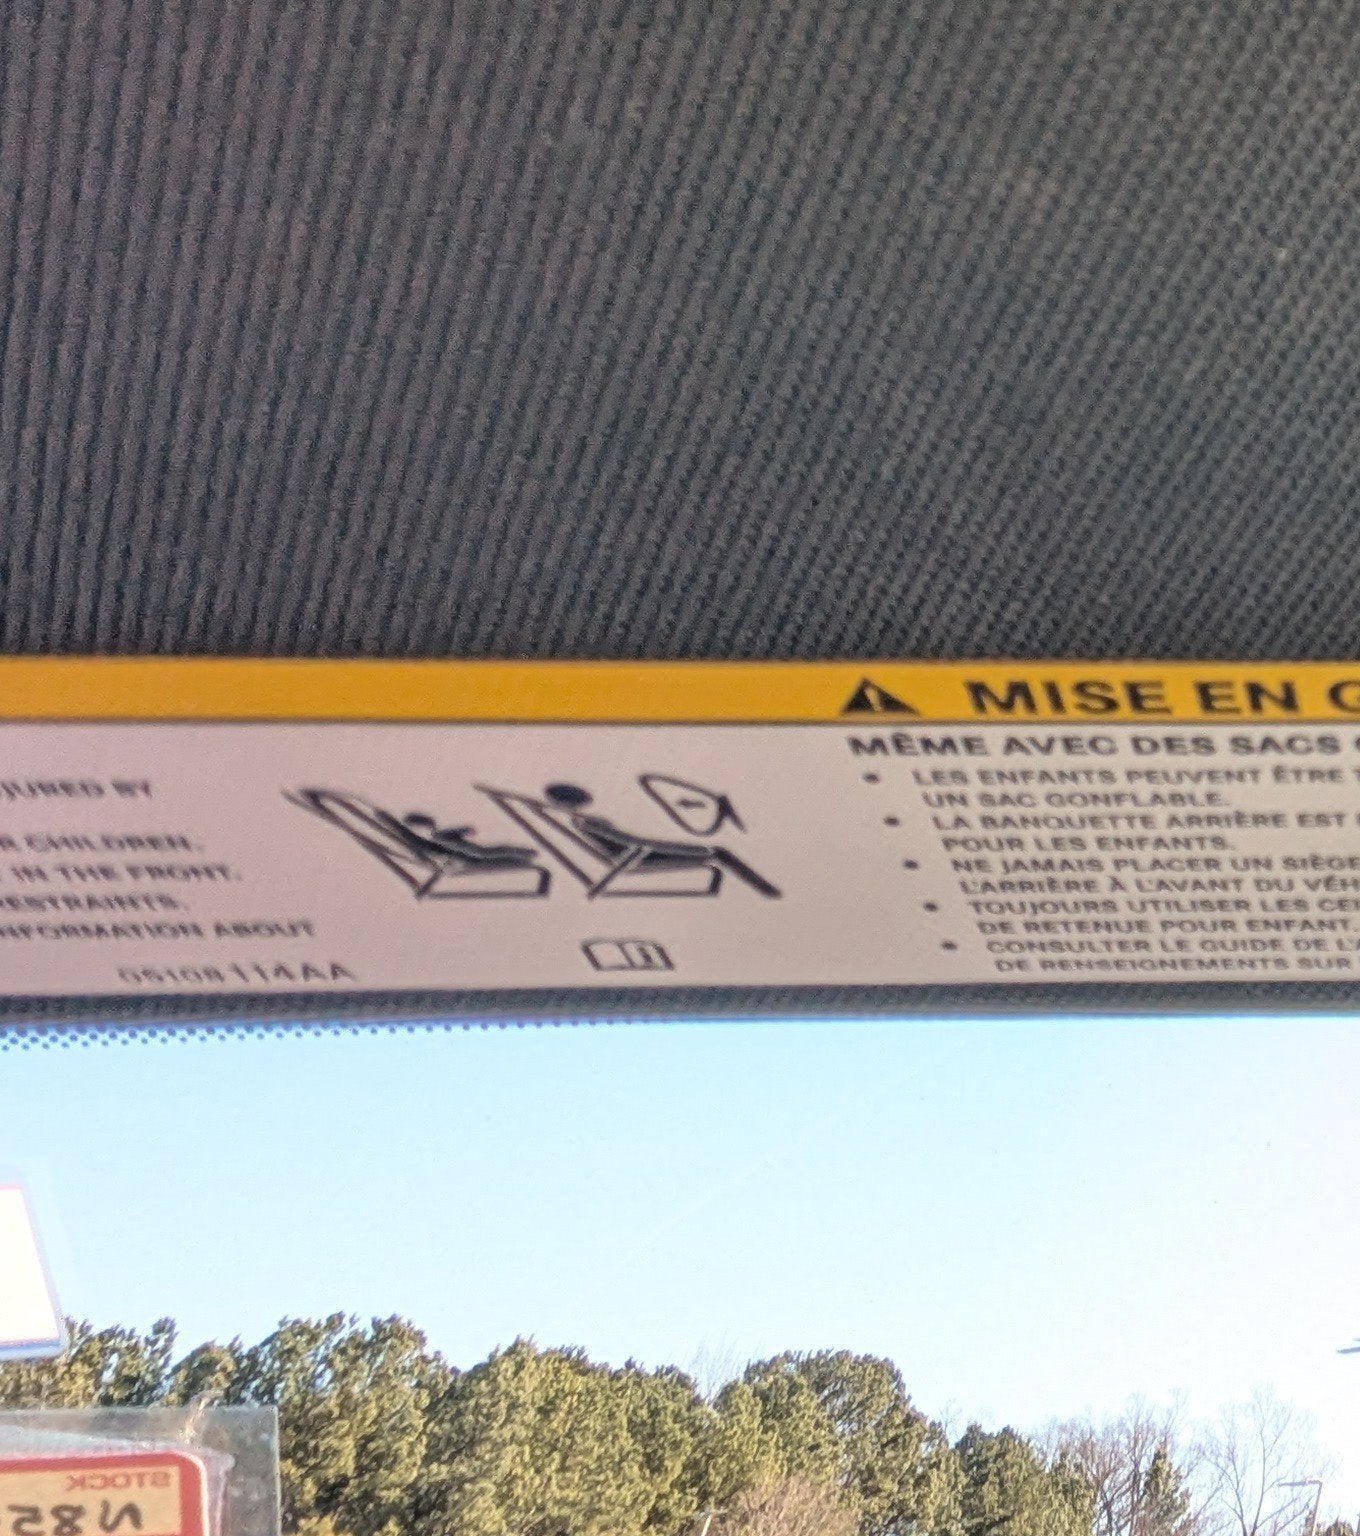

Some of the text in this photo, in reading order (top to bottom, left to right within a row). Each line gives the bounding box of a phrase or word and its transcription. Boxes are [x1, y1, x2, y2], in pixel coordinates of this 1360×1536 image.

[964, 680, 1174, 715] MISE
[1195, 680, 1300, 714] EN
[848, 731, 989, 756] MÊME
[1002, 735, 1118, 756] AVEC
[1132, 735, 1215, 755] DES
[1230, 734, 1340, 754] SACS
[913, 771, 968, 785] LES
[978, 770, 1116, 785] ENFANTS
[1127, 769, 1260, 785] PEUVENT
[925, 793, 967, 807] UN
[979, 793, 1036, 807] SAC
[935, 815, 970, 830] LA
[980, 815, 1157, 831] BANQUETTE
[1166, 810, 1287, 828] ARRIÈRE
[1298, 813, 1345, 828] EST
[942, 837, 1024, 852] POUR
[1034, 837, 1087, 851] LES
[11, 864, 49, 882] IN
[55, 864, 118, 882] THE
[952, 859, 992, 874] NE
[1001, 859, 1104, 875] JAMAIS
[1114, 858, 1222, 873] PLACER
[1231, 858, 1272, 872] UN
[1135, 878, 1243, 893] L'AVANT
[1255, 878, 1294, 892] DU
[971, 901, 1118, 916] TOUJOURS
[1127, 900, 1251, 914] UTILISER
[1260, 900, 1309, 913] LES
[213, 919, 314, 938] ABOUT
[978, 921, 1017, 935] DE
[1024, 920, 1150, 934] RETENUE
[1160, 920, 1235, 933] POUR
[987, 940, 1150, 955] CONSULTER
[1161, 939, 1193, 954] LE
[1200, 939, 1283, 953] GUIDE
[1294, 939, 1329, 952] DE
[996, 959, 1031, 972] DE
[1041, 958, 1289, 971] RENSEIGNEMENTS
[1298, 957, 1351, 971] SUR
